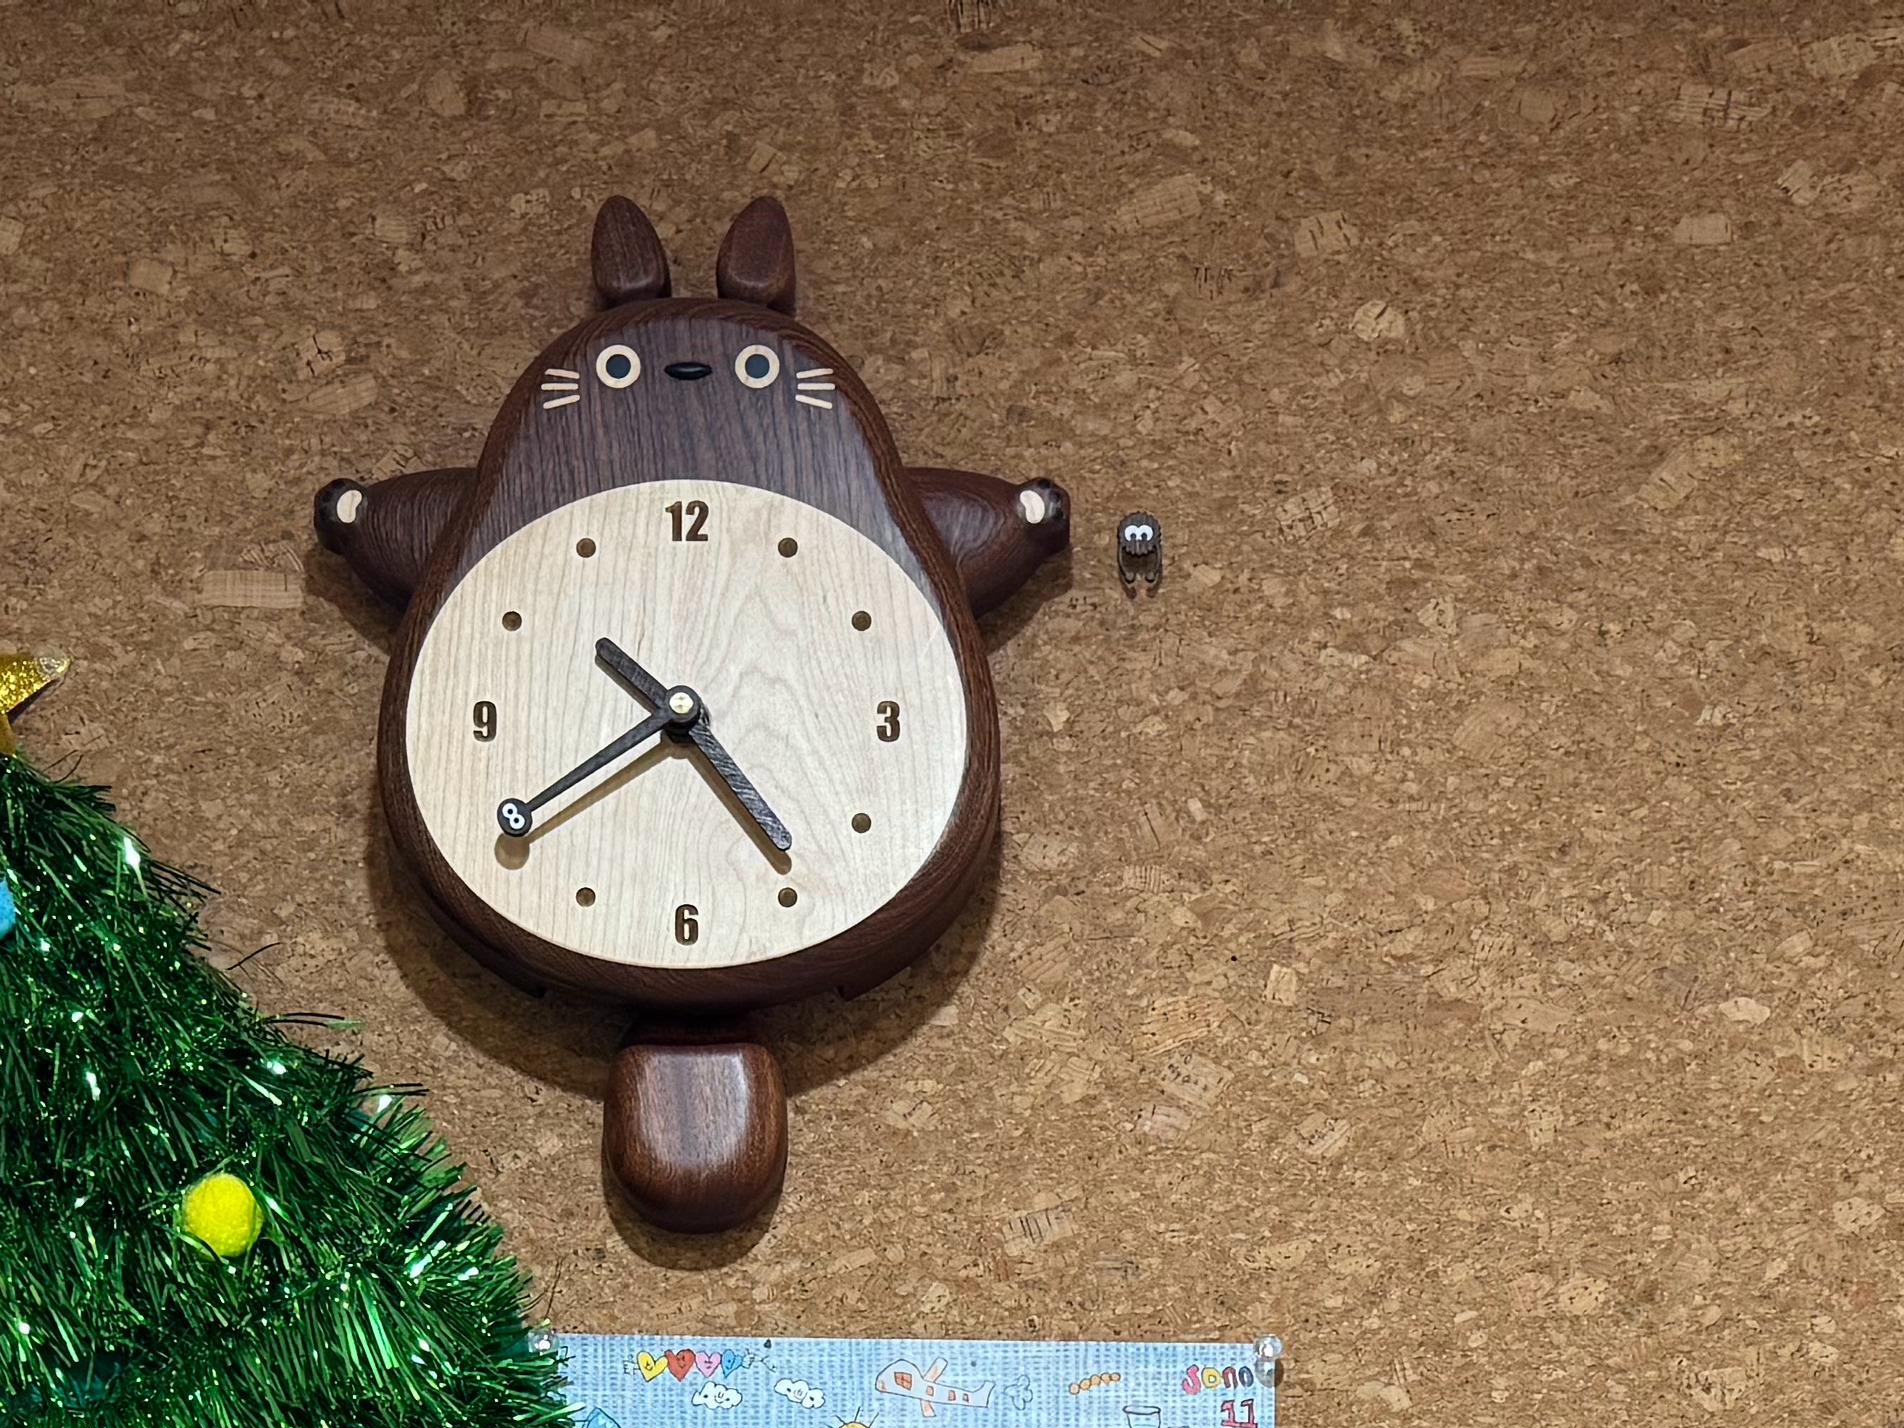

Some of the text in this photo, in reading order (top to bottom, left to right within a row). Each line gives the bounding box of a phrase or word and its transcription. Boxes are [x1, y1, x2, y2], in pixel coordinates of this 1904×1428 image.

[665, 500, 709, 542] 12
[472, 700, 498, 742] 9
[876, 700, 901, 742] 3
[674, 904, 699, 945] 6
